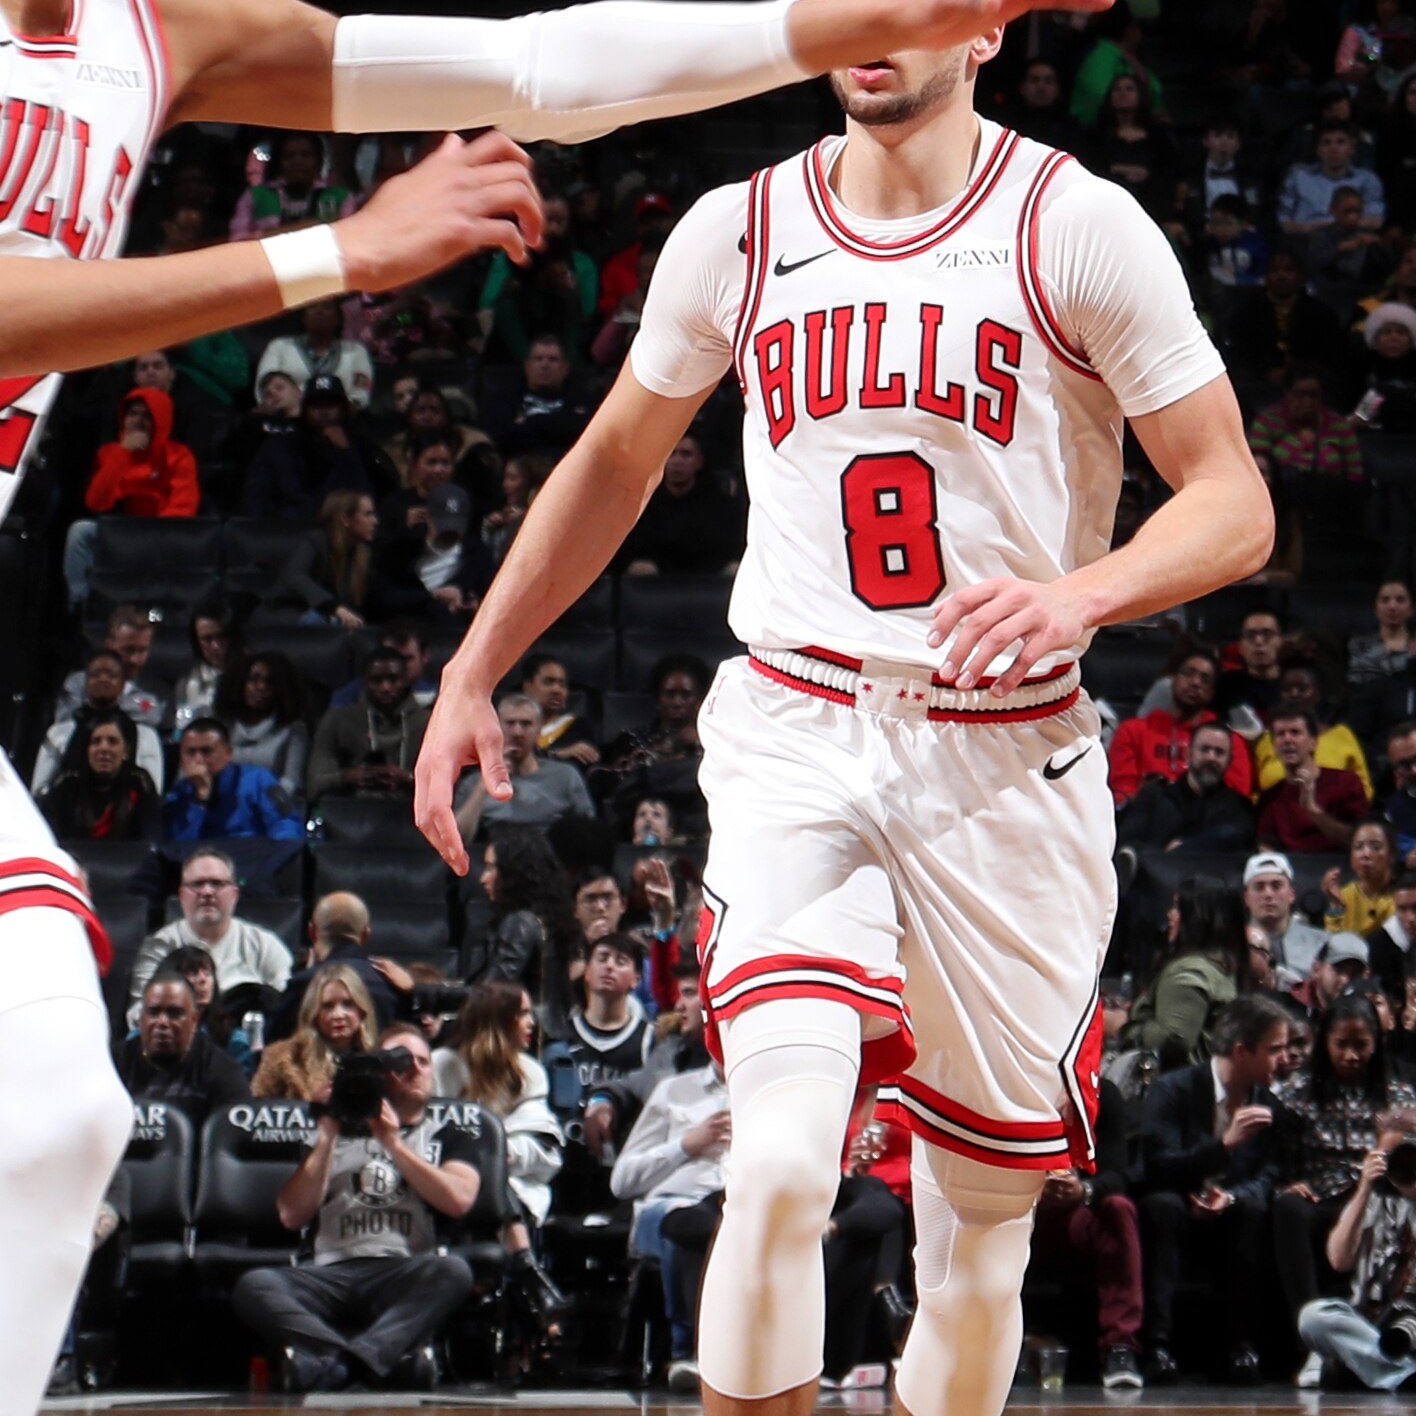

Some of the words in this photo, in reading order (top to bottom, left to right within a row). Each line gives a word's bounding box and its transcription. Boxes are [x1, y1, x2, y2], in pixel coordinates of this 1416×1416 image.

[0, 96, 133, 260] ULLS
[754, 302, 1023, 452] BULLS
[840, 450, 948, 612] 8
[228, 1104, 317, 1132] QATA
[427, 1104, 481, 1125] TAR
[340, 1211, 412, 1238] PHOTO
